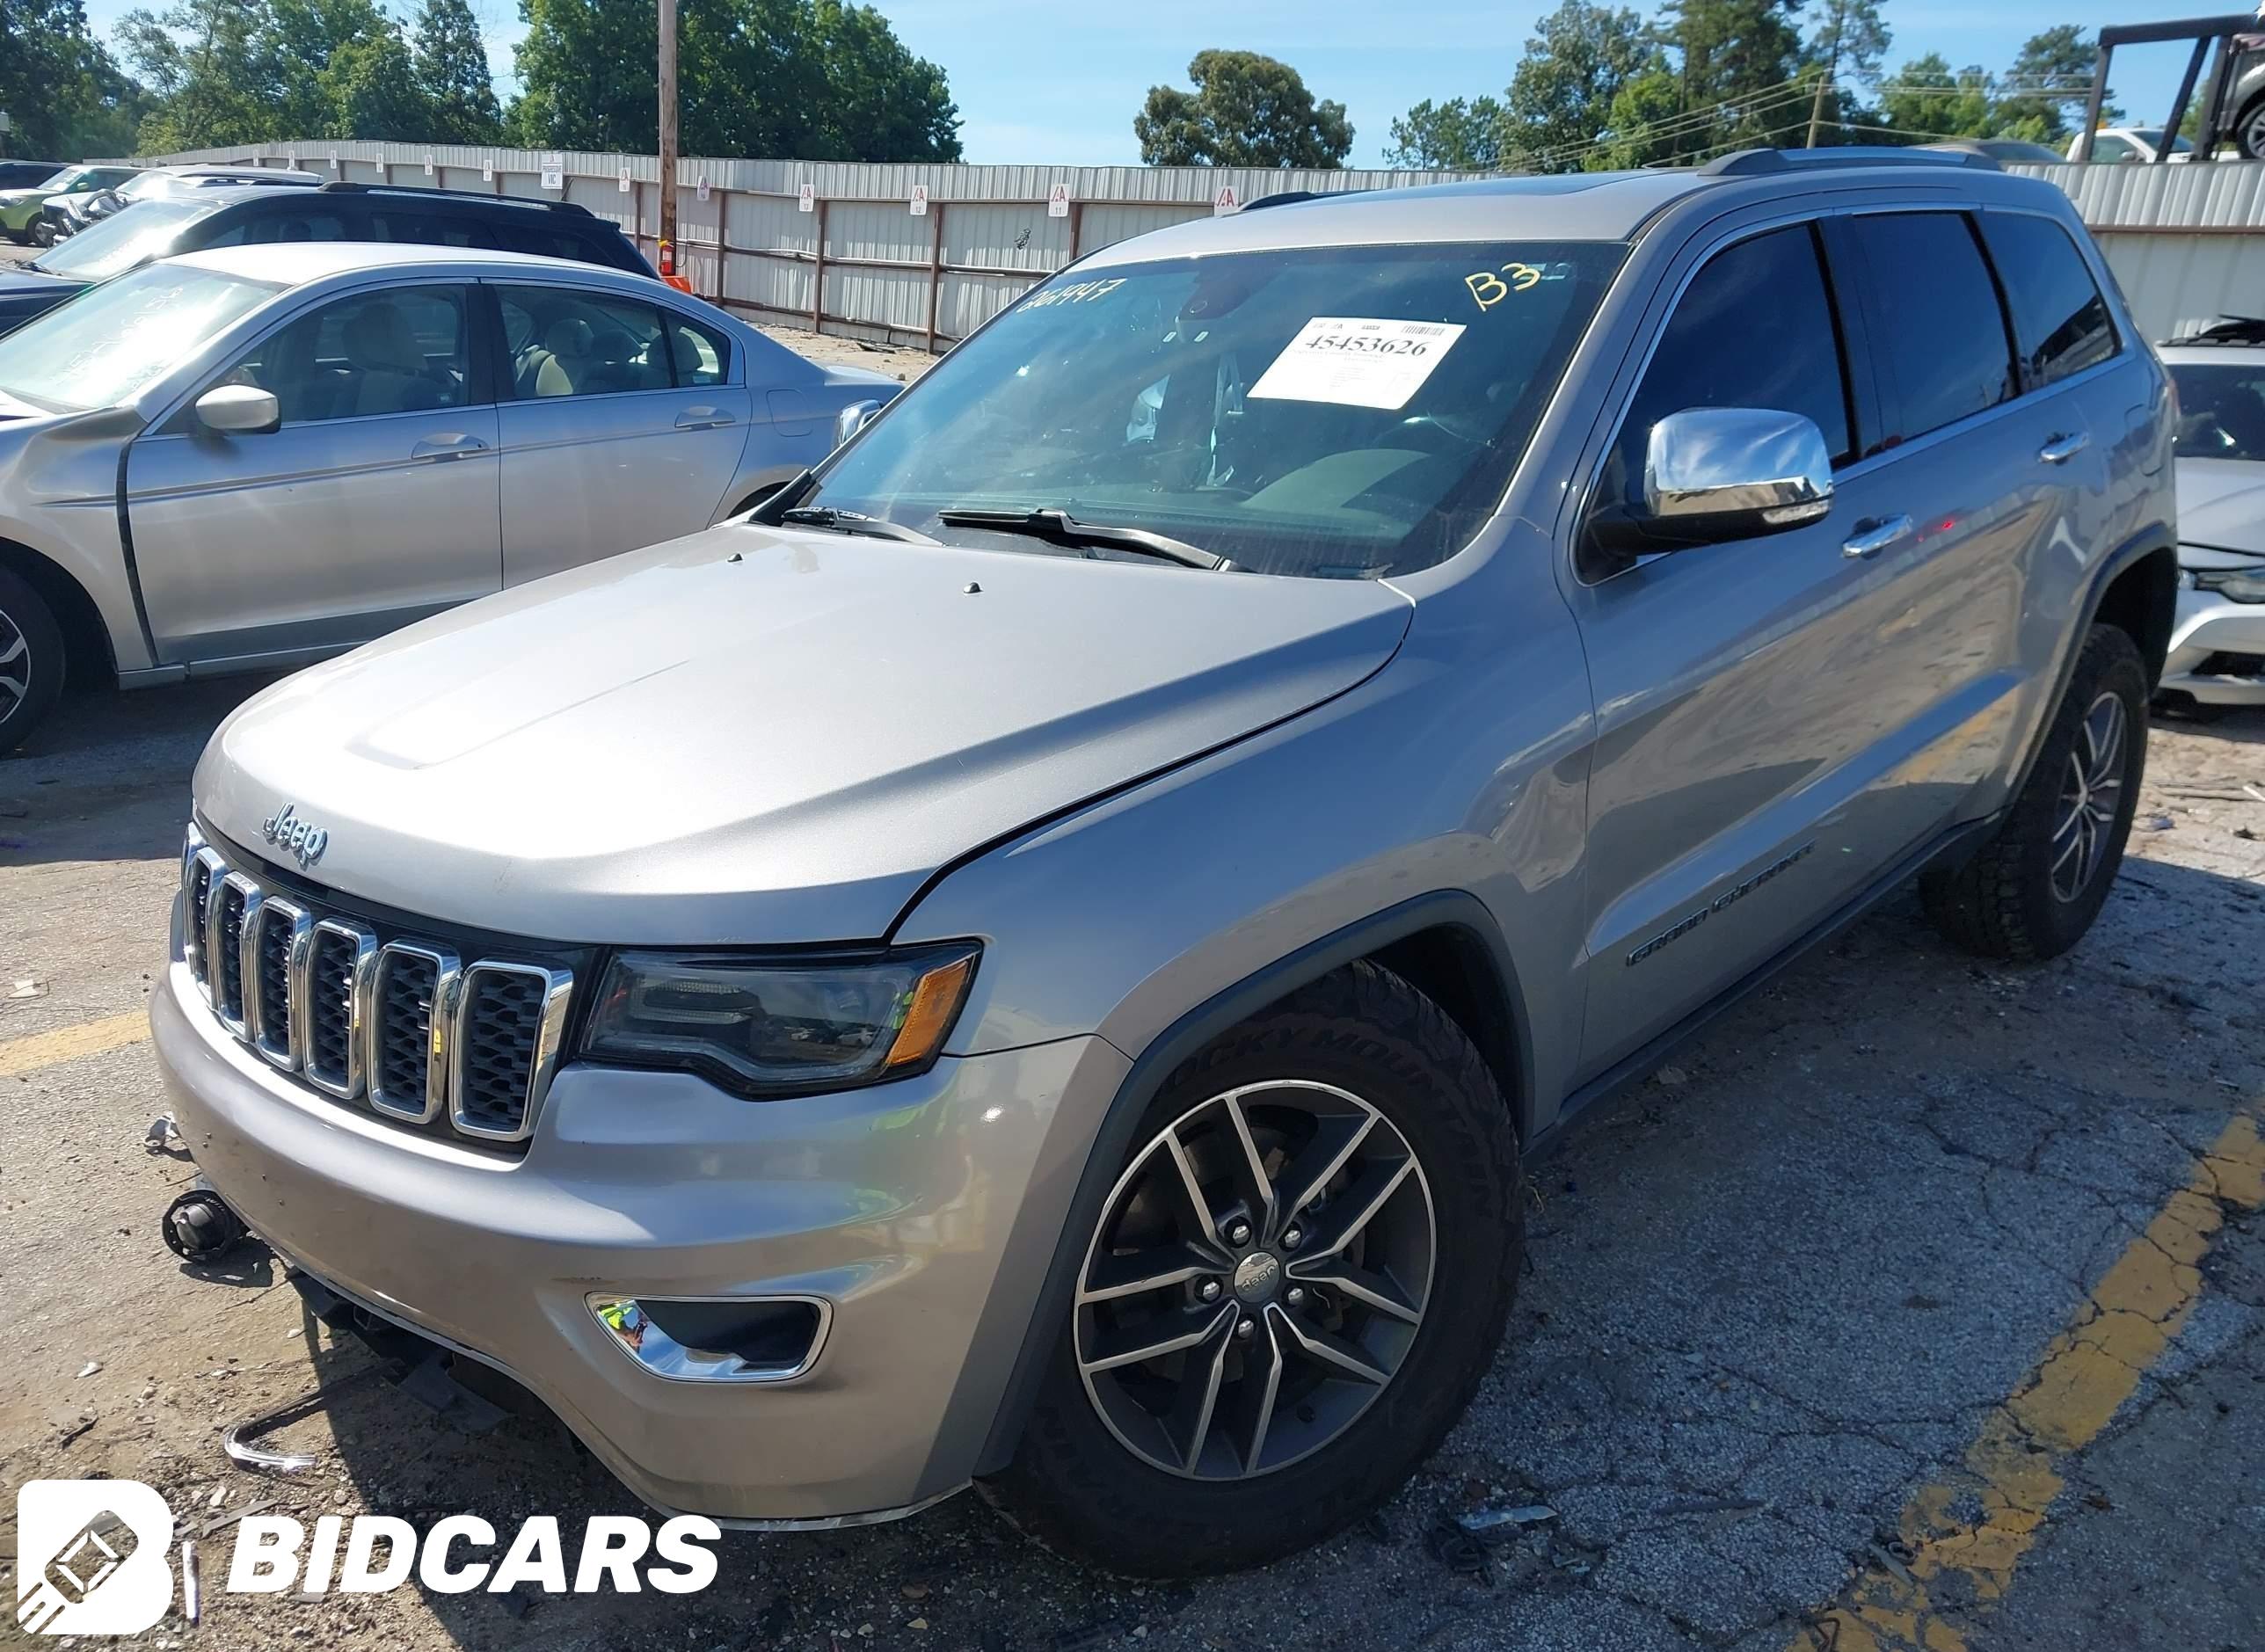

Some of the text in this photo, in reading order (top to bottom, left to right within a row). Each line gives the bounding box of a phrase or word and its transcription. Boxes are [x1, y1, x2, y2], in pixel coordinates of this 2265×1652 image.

[1305, 334, 1432, 357] 45453626
[262, 801, 329, 867] Jeep
[1241, 1264, 1276, 1292] Jeep
